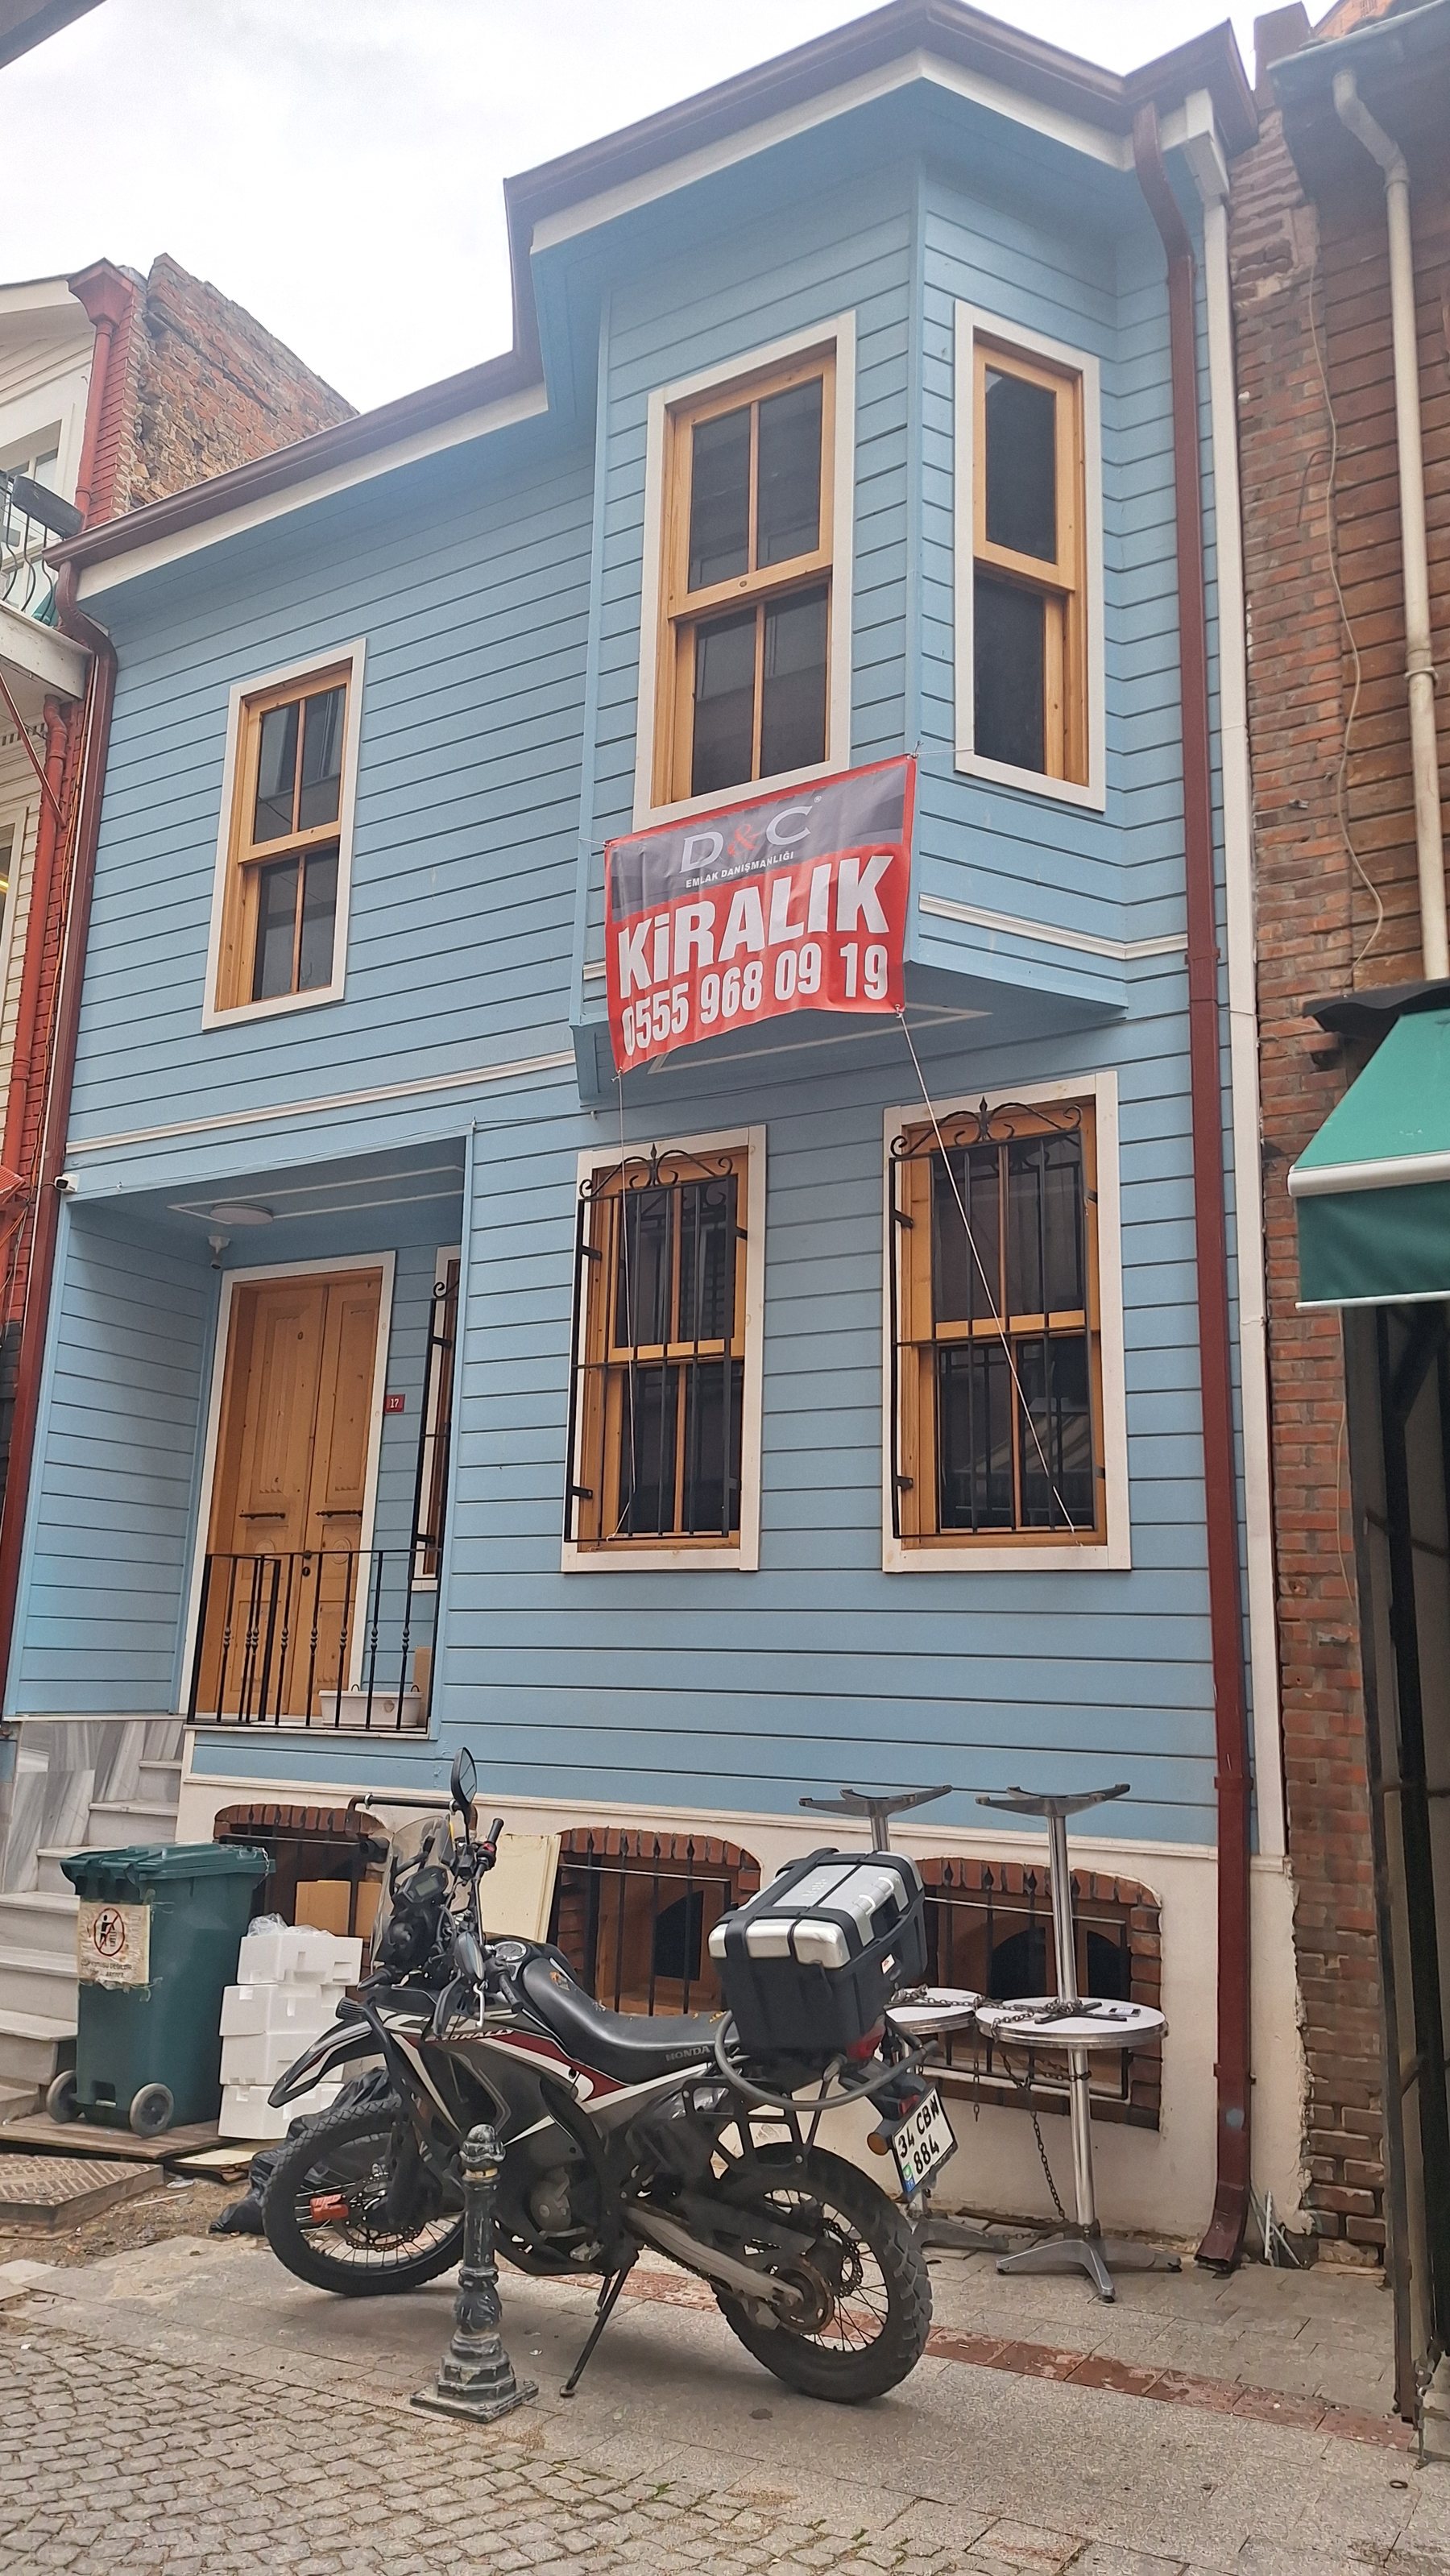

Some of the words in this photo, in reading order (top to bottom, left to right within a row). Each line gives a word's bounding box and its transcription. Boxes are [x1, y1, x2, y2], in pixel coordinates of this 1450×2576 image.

[685, 872, 719, 888] EMLAK
[720, 851, 794, 878] DANIŞMANLIĞI
[621, 982, 690, 1056] 0555
[700, 960, 764, 1025] 968
[774, 942, 822, 1000] 09
[839, 942, 889, 1000] 19
[390, 1398, 400, 1409] 17
[458, 2027, 515, 2040] RALLY
[665, 2045, 710, 2061] HONDA
[898, 2127, 915, 2158] 34
[916, 2094, 940, 2135] CBW
[914, 2134, 940, 2174] 884
